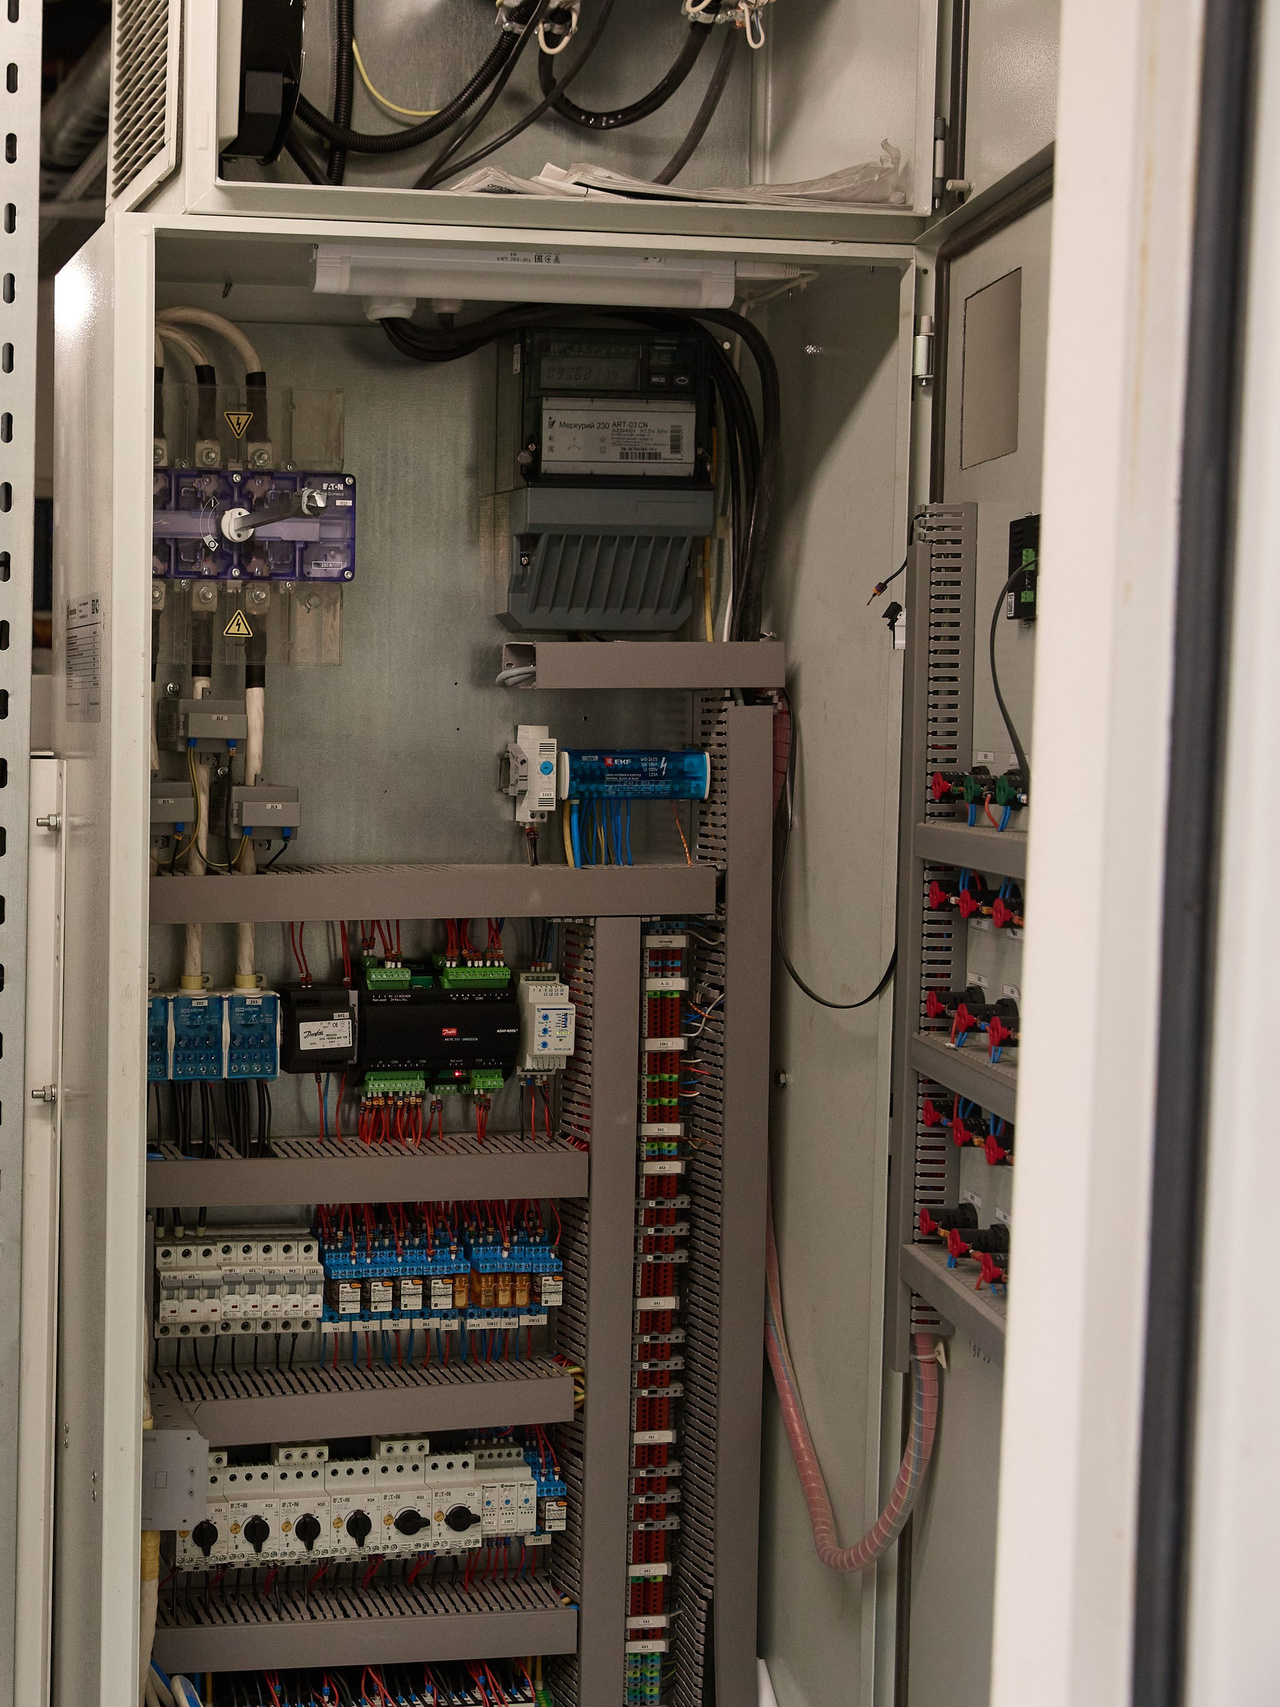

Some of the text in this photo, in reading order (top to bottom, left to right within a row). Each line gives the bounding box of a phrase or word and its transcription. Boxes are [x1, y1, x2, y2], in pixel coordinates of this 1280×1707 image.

[559, 421, 595, 431] Меркурий
[596, 422, 610, 430] 230
[611, 421, 637, 429] ART-03
